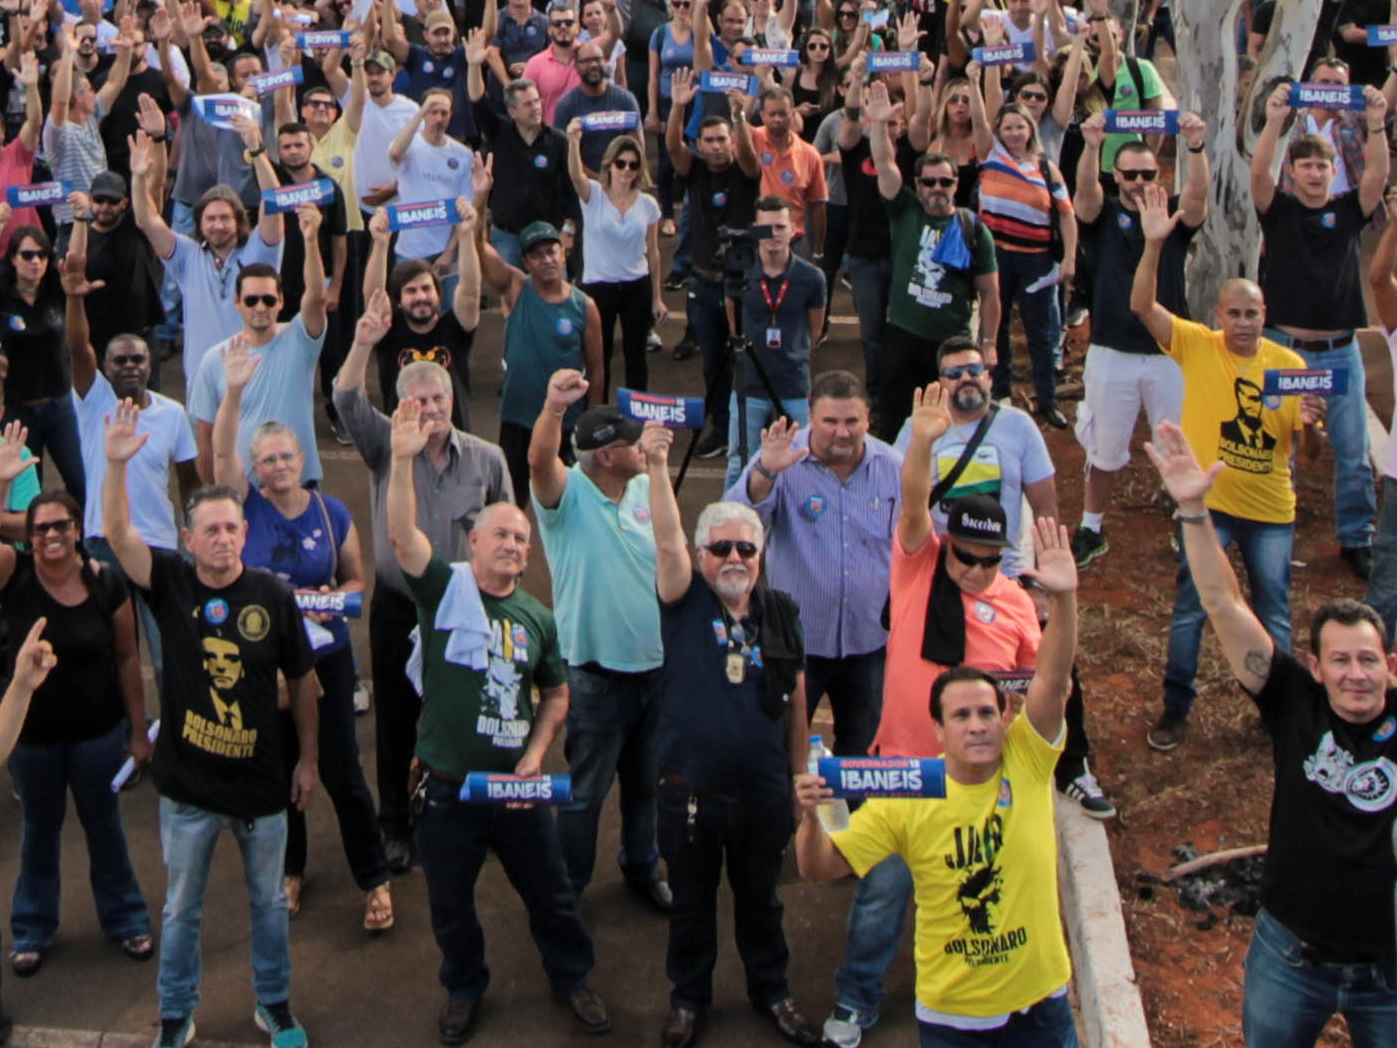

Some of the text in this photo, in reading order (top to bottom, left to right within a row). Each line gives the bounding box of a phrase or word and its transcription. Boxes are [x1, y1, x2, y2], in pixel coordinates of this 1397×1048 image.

[751, 51, 788, 65] IBANEIS
[871, 55, 910, 69] IBANEIS
[981, 47, 1023, 64] IBANEIS
[708, 74, 746, 90] IBANEIS
[1298, 89, 1349, 106] IBANEIS
[1115, 114, 1163, 130] IBANEIS
[18, 185, 63, 202] IBANEIS
[274, 186, 322, 206] IBANEIS
[398, 204, 447, 224] IBANEIS
[1278, 375, 1333, 390] IBANEIS
[630, 400, 686, 423] IBANEIS
[295, 592, 346, 611] ANEIS
[184, 708, 258, 745] BOLSONARO
[840, 769, 923, 790] IBANEIS
[487, 781, 552, 799] IBANEIS
[944, 926, 1027, 957] BOLSONARO
